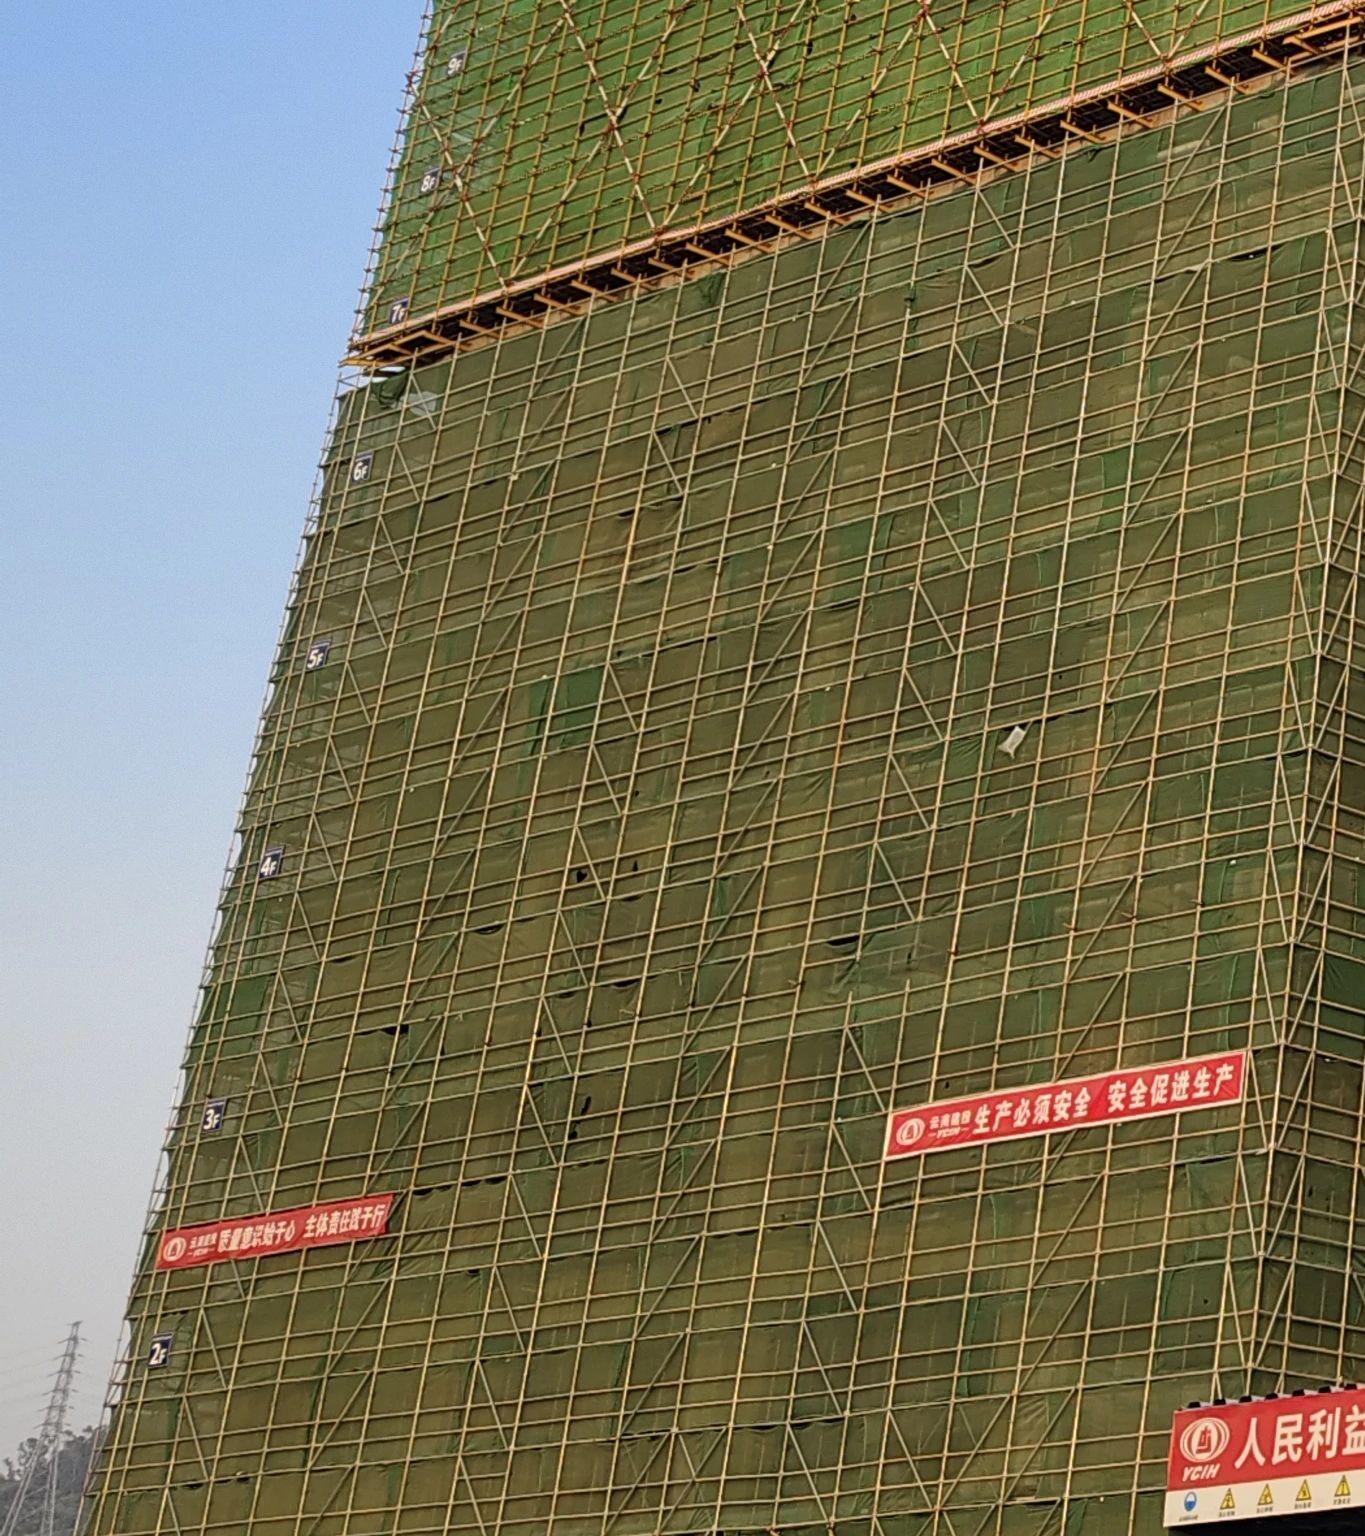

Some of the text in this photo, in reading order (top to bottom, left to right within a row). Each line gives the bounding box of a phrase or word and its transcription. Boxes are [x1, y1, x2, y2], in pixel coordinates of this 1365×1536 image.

[421, 175, 436, 192] 8F
[391, 304, 405, 323] 7F
[353, 462, 368, 480] 6F
[306, 649, 324, 668] 5F
[260, 857, 277, 876] 4F
[974, 1063, 1235, 1134] 生产必须安全 安全促进生产
[203, 1109, 220, 1130] 3F
[148, 1343, 167, 1365] 2F
[1182, 1463, 1221, 1482] YCIH
